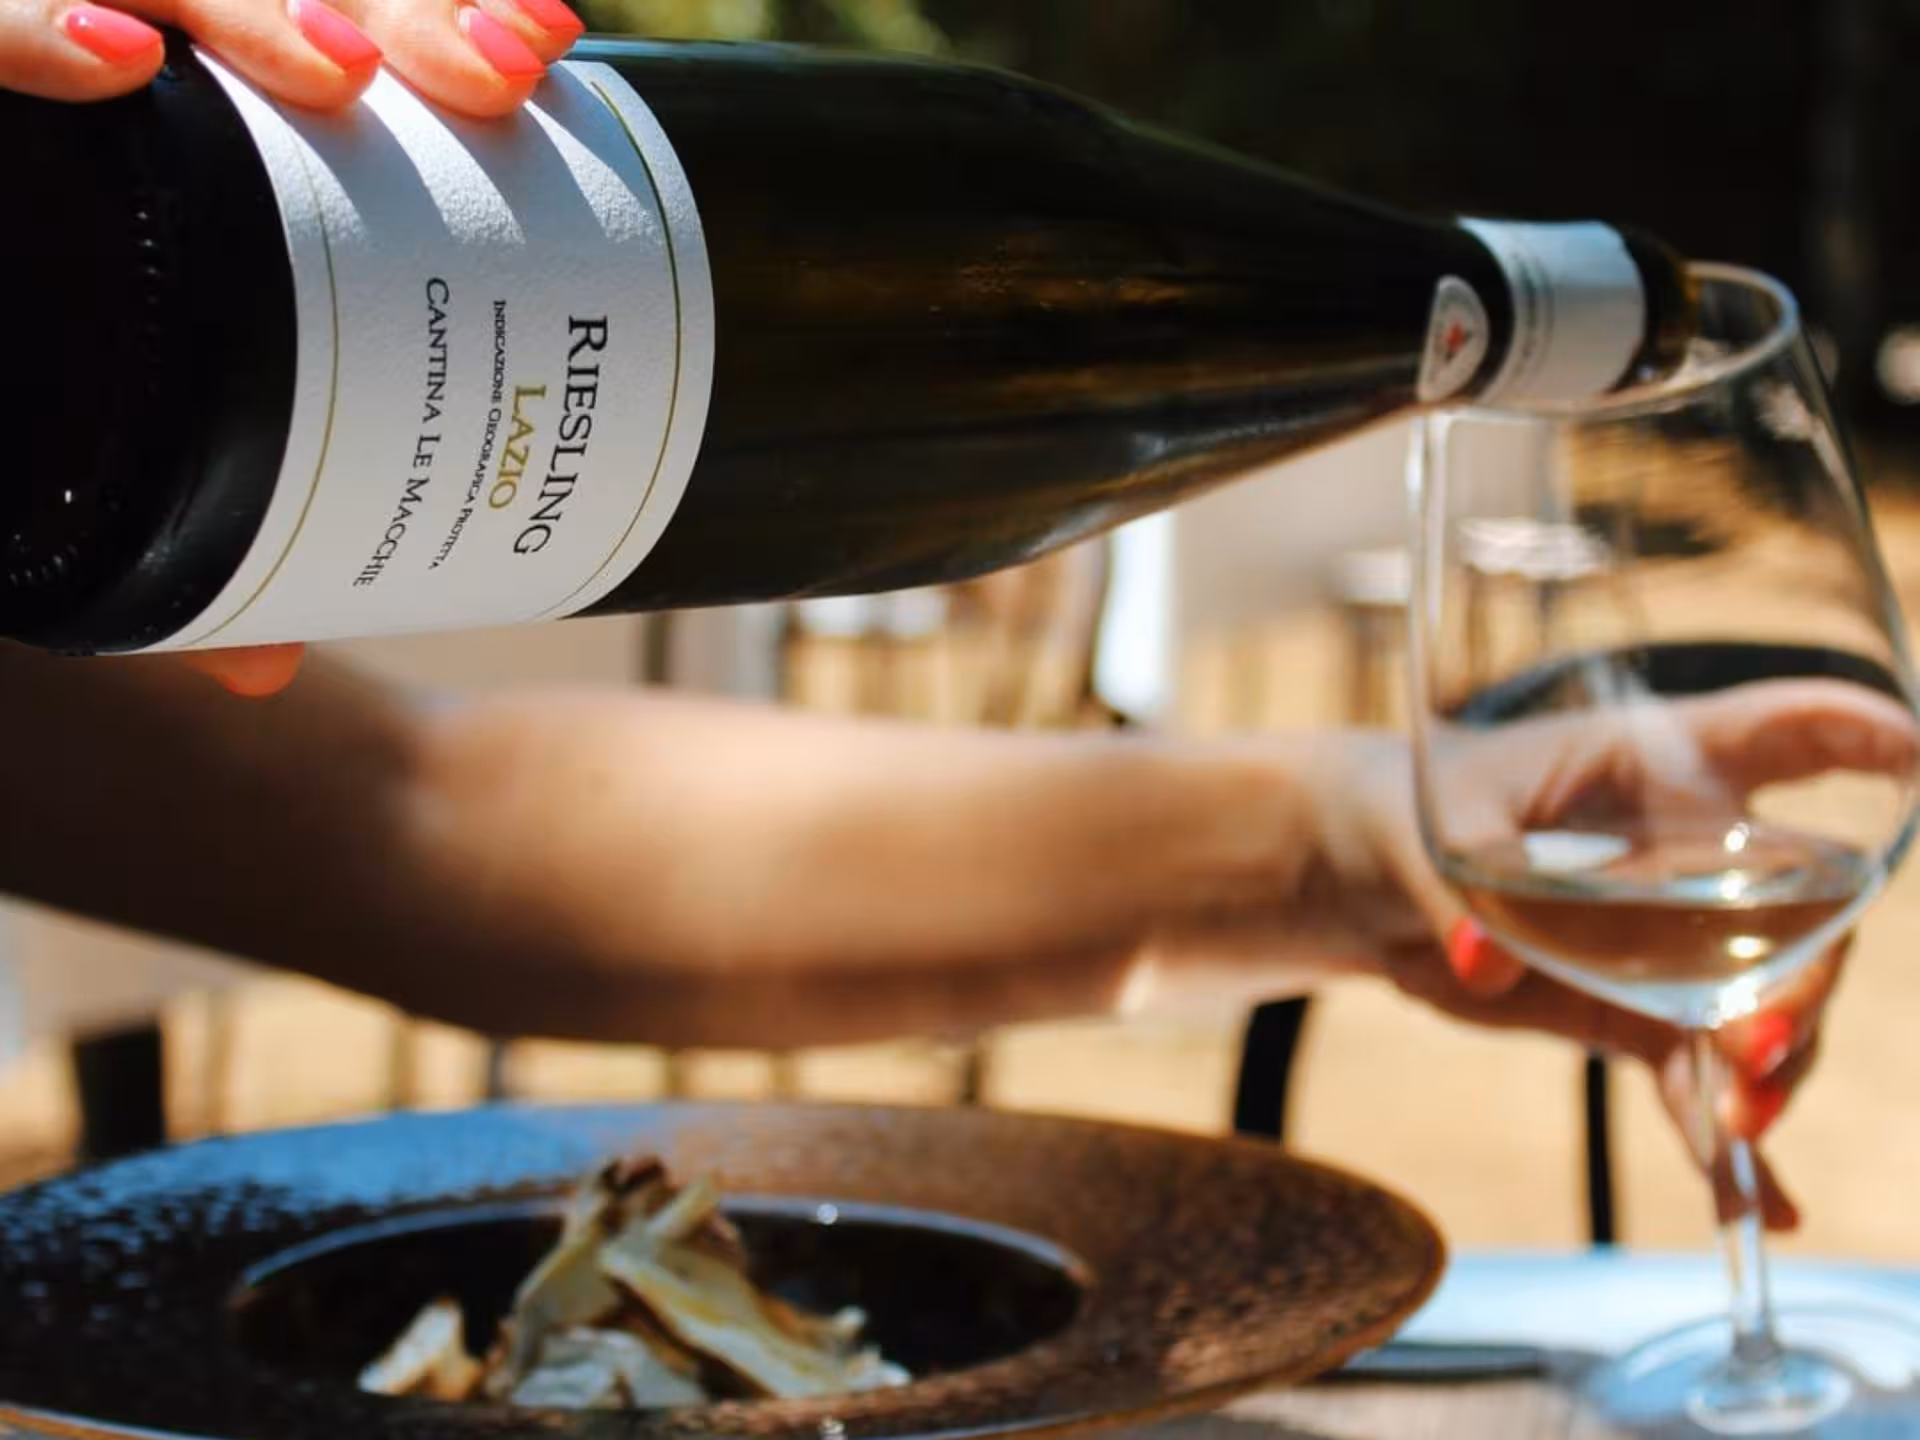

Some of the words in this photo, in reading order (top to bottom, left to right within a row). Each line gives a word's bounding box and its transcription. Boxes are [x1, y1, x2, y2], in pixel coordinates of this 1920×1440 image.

[422, 277, 449, 422] CANTINA
[491, 300, 506, 403] INDICAZIONE
[412, 433, 441, 469] LE
[464, 408, 501, 504] GEOGRAFICA
[488, 384, 547, 509] LAZIO
[513, 315, 609, 555] RIESLING
[352, 477, 430, 587] MACCHIE
[428, 507, 473, 570] PROTETTA
